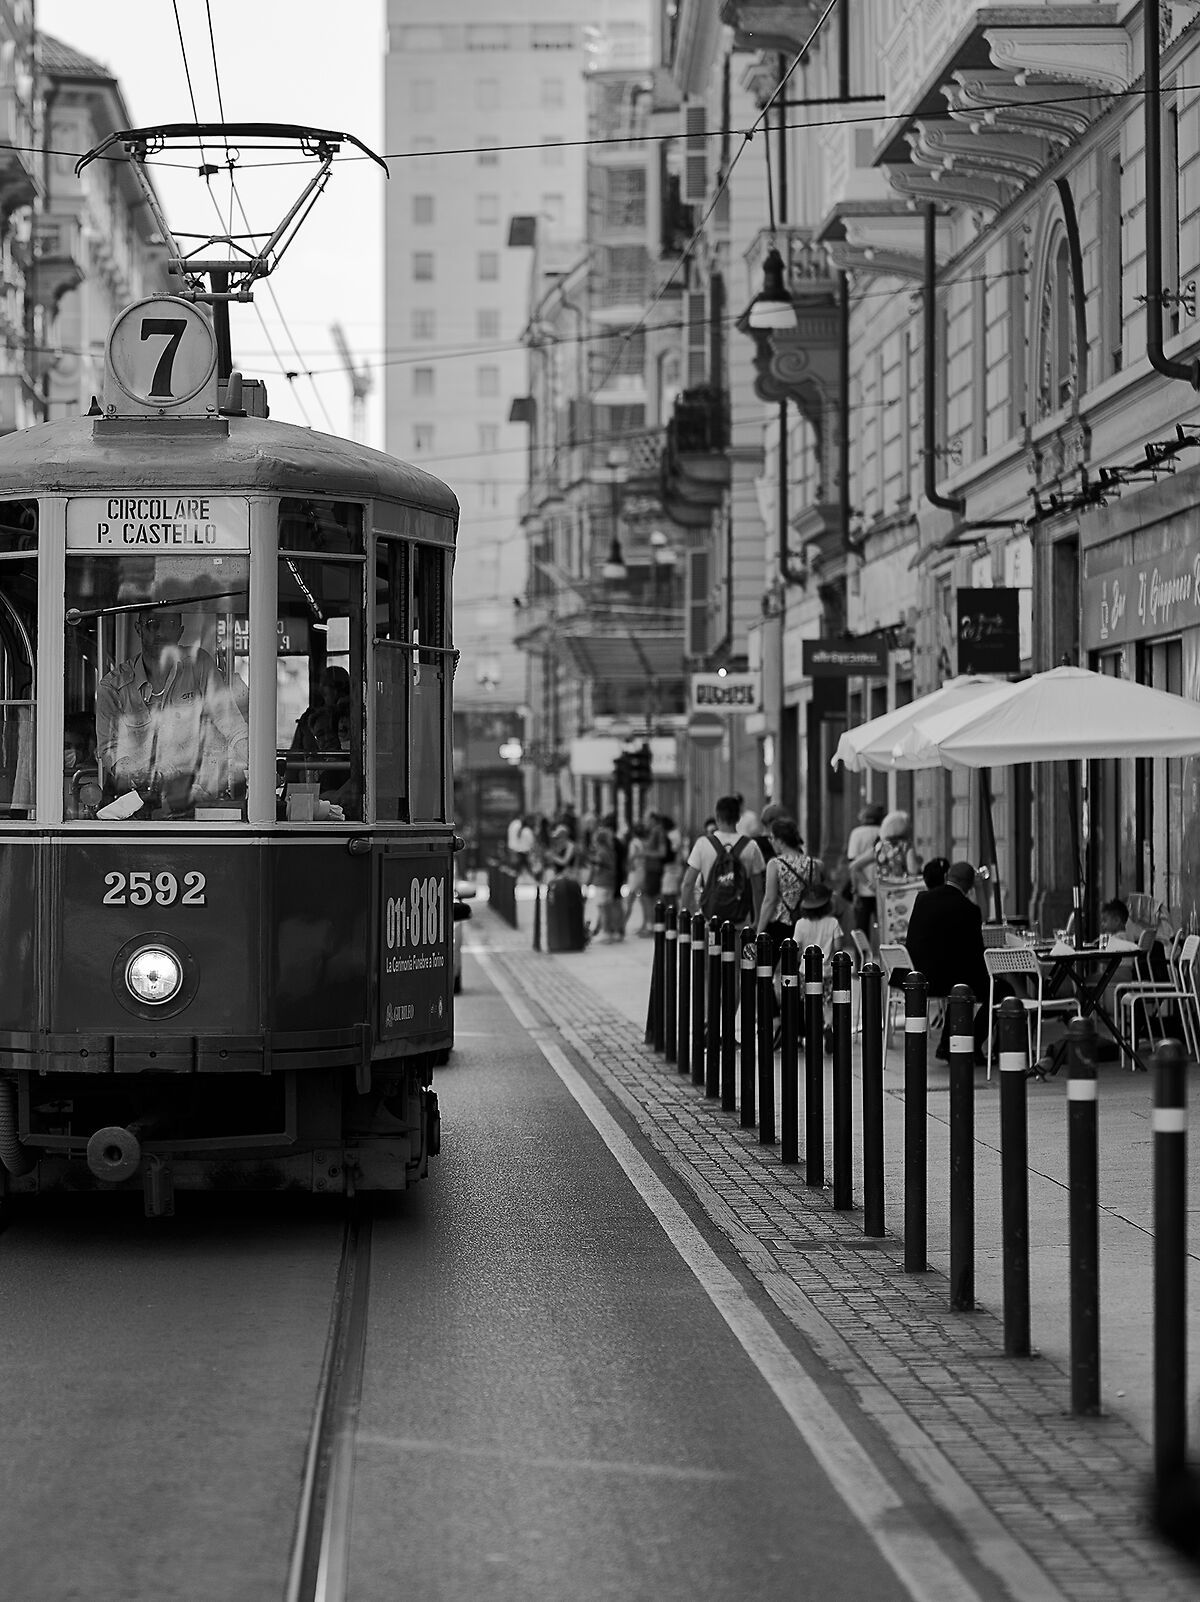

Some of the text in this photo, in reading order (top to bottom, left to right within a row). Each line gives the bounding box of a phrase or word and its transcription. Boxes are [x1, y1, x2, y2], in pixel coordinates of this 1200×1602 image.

[141, 319, 187, 397] 7
[107, 499, 210, 520] CIRCOLARE
[97, 523, 217, 544] P. CASTELLO
[102, 871, 207, 907] 2592
[386, 876, 445, 949] 011-8181
[386, 957, 392, 973] La
[392, 955, 413, 973] Cerimonia
[432, 952, 445, 968] Torino
